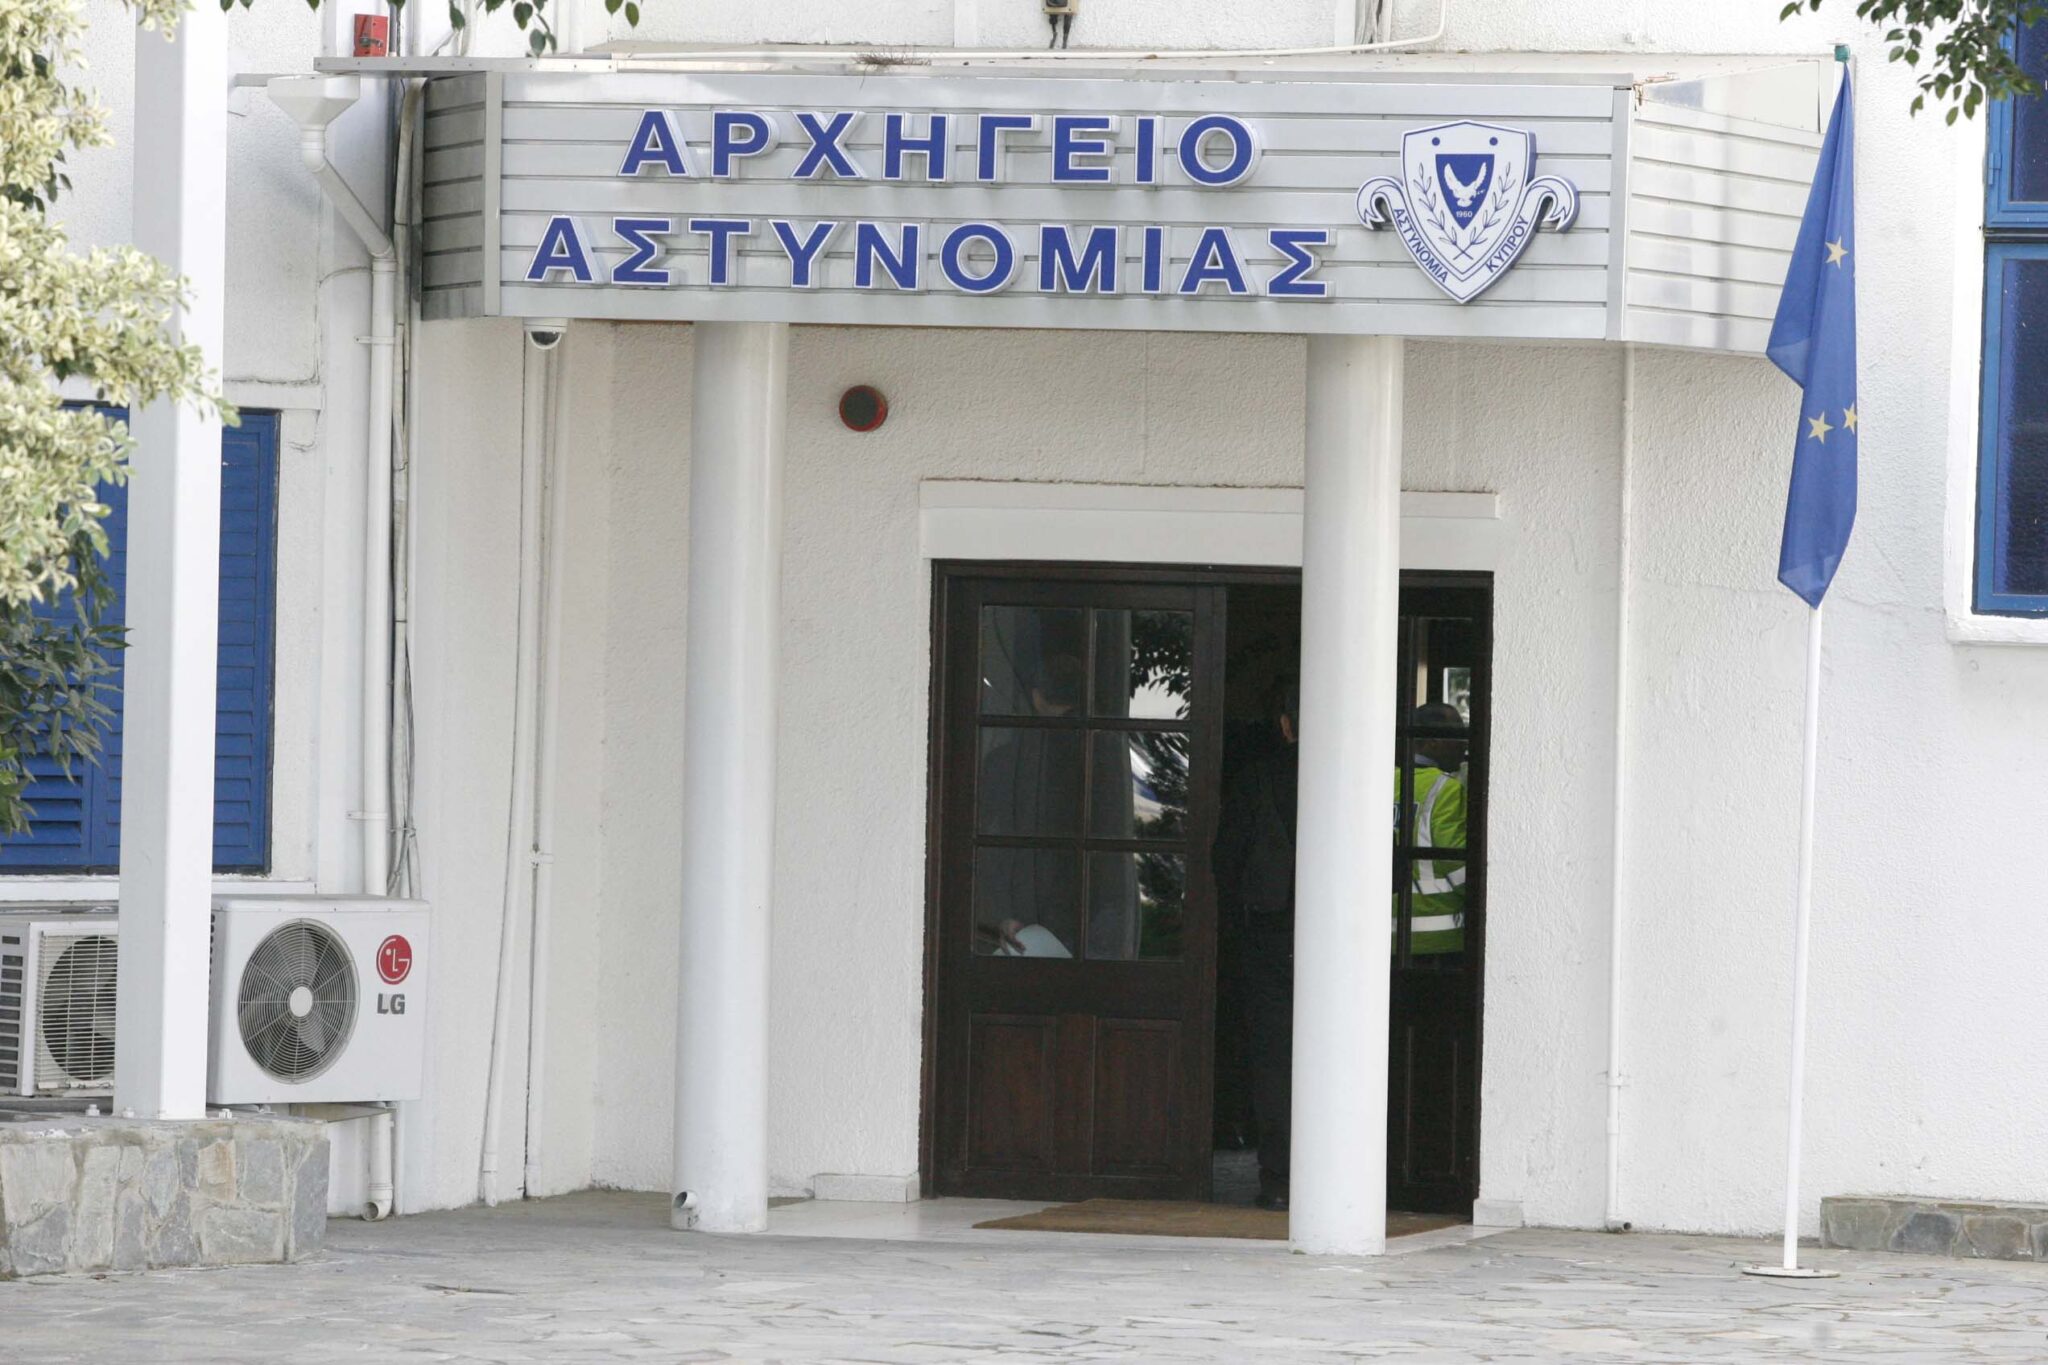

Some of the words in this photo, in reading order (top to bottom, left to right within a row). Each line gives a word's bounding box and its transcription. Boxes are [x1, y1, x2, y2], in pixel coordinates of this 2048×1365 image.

[617, 109, 1256, 187] ΑΡΧΗΓΕΙΟ
[1393, 207, 1449, 284] ΑΣΤΥΝΟΜΙΑ
[1485, 214, 1530, 274] ΚΥΠΡΟΥ
[1455, 210, 1473, 218] 1960
[524, 214, 1330, 298] ΑΣΤΥΝΟΜΙΑΣ
[377, 993, 405, 1014] LG
